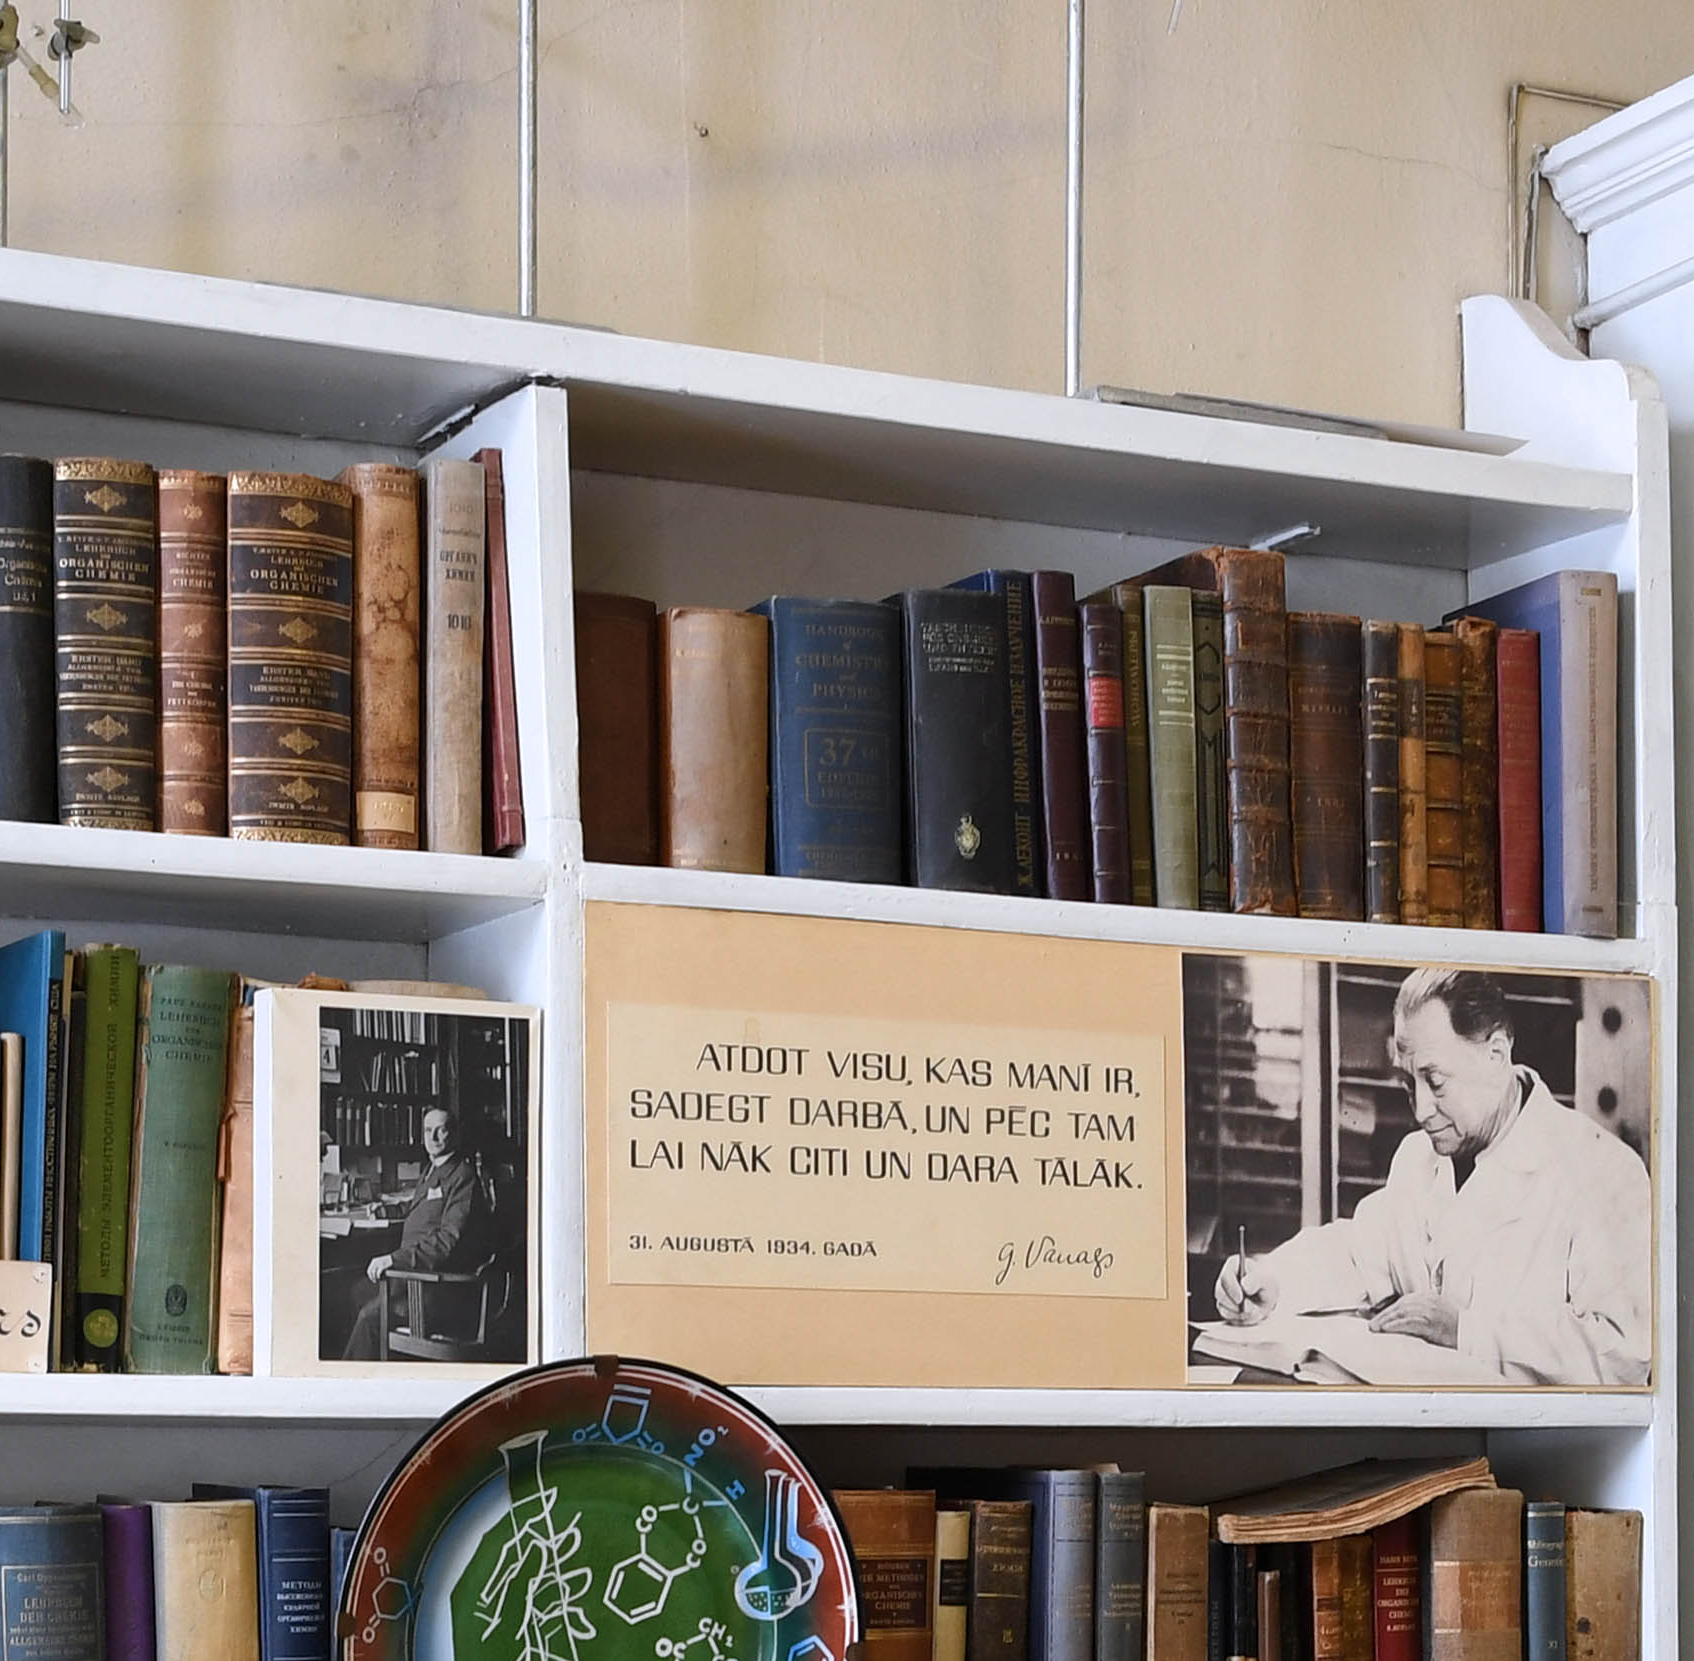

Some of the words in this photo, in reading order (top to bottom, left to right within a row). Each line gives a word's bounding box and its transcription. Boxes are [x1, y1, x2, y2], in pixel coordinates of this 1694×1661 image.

[696, 1043, 810, 1076] ATDOT
[827, 1050, 914, 1088] VISU,
[925, 1056, 993, 1088] KAS
[1007, 1061, 1092, 1093] MANĪ
[1105, 1066, 1141, 1100] IR,
[631, 1090, 770, 1124] SADEGT
[789, 1096, 918, 1137] DARBĀ,
[925, 1104, 971, 1135] UN
[985, 1105, 1051, 1139] PĒC
[1068, 1113, 1136, 1143] TAM
[630, 1139, 684, 1170] LAI
[700, 1140, 773, 1175] NĀK
[789, 1146, 849, 1178] CITI
[865, 1150, 911, 1180] UN
[927, 1153, 1019, 1185] DARA
[1034, 1156, 1143, 1191] TĀLĀK.
[629, 1235, 654, 1251] 31.
[660, 1235, 755, 1254] AUGUSTĀ
[767, 1239, 816, 1256] 1934.
[823, 1240, 877, 1258] GADĀ
[1024, 1235, 1116, 1278] Vanags
